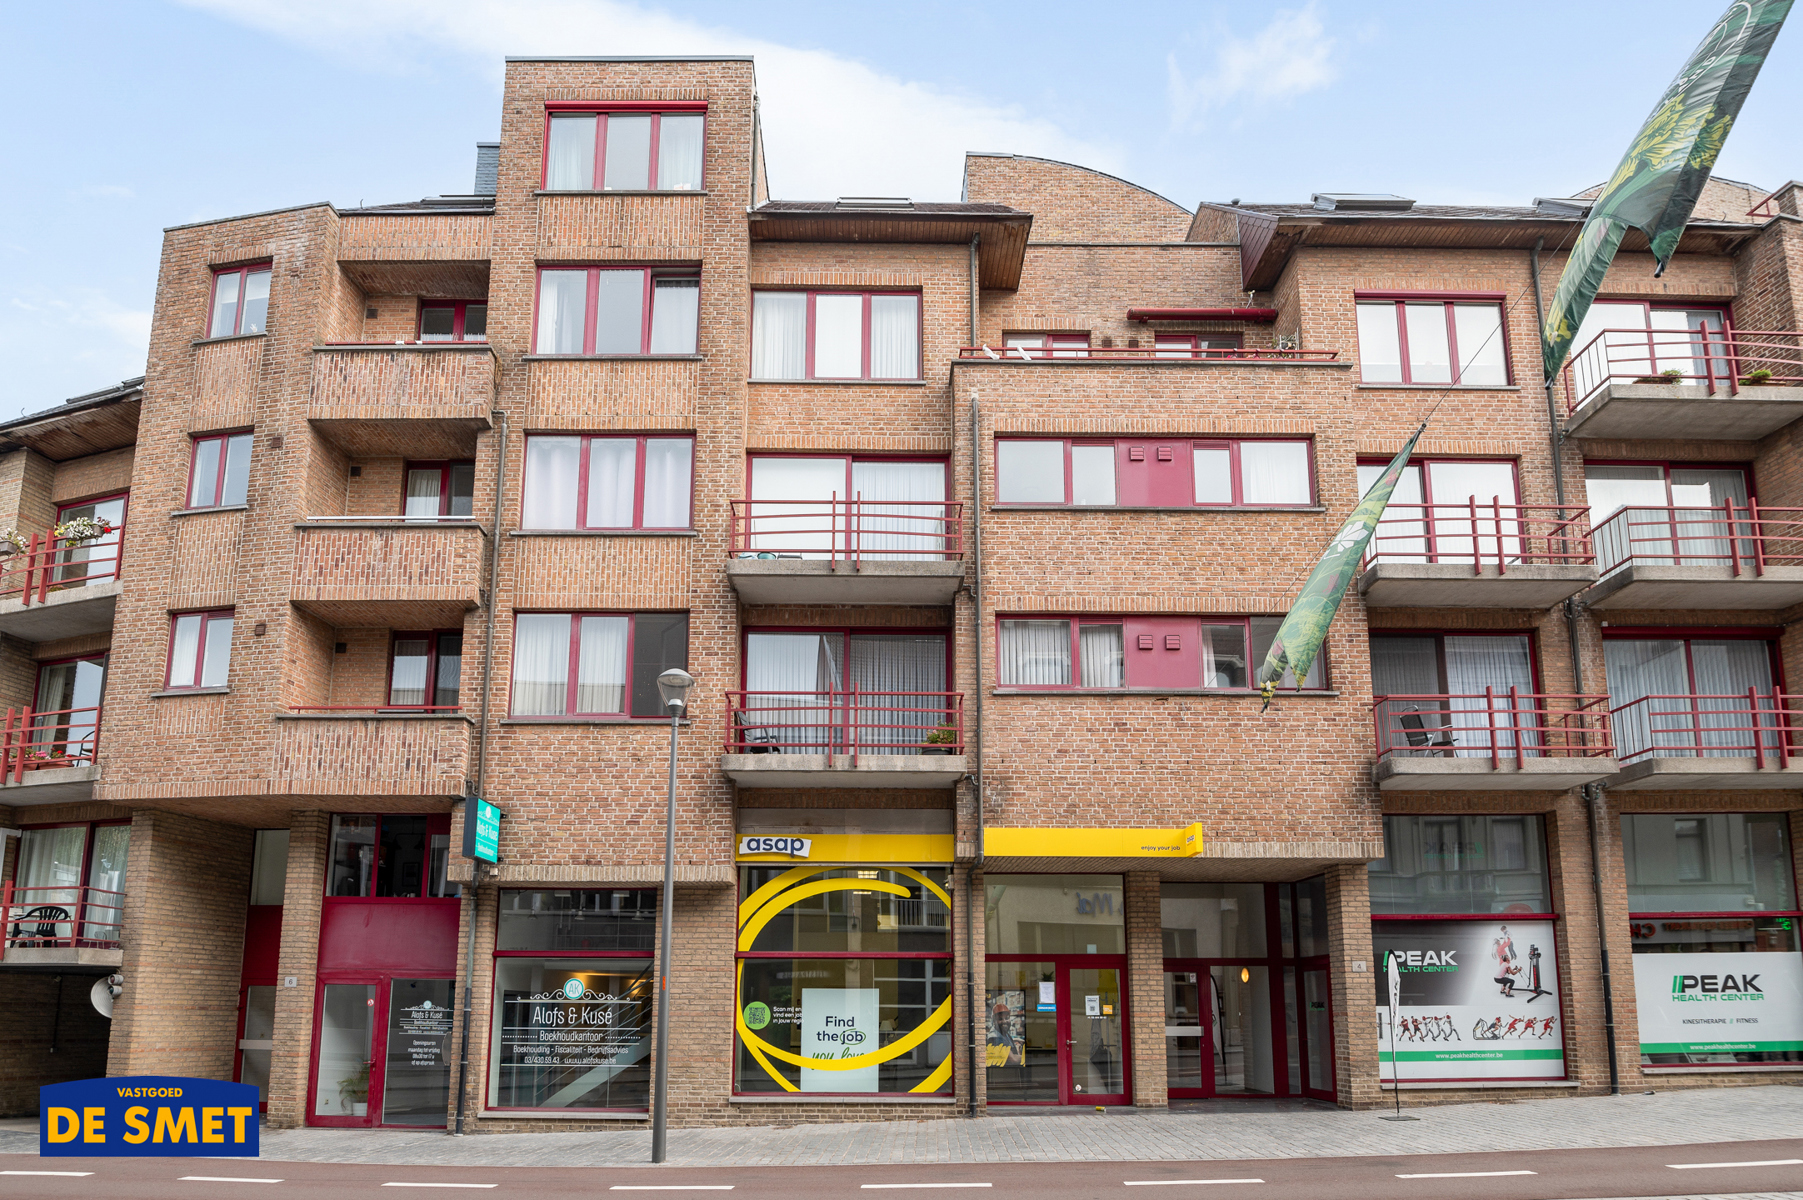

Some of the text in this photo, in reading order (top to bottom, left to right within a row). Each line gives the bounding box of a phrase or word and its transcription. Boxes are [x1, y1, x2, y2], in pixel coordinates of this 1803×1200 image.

[746, 838, 804, 858] asap
[1422, 965, 1459, 973] CENTER
[568, 983, 580, 995] AK
[1680, 974, 1764, 993] PEAK
[1672, 993, 1765, 1002] HEALTH CENTER
[532, 1006, 613, 1027] Alofs & Kusé
[825, 1016, 854, 1027] Find
[540, 1030, 603, 1042] Boekhoudkantoor
[816, 1030, 864, 1045] the job
[513, 1045, 550, 1055] Boekhouding
[555, 1045, 583, 1054] Fiscaliteit
[587, 1045, 629, 1055] Bedrijfsadvies
